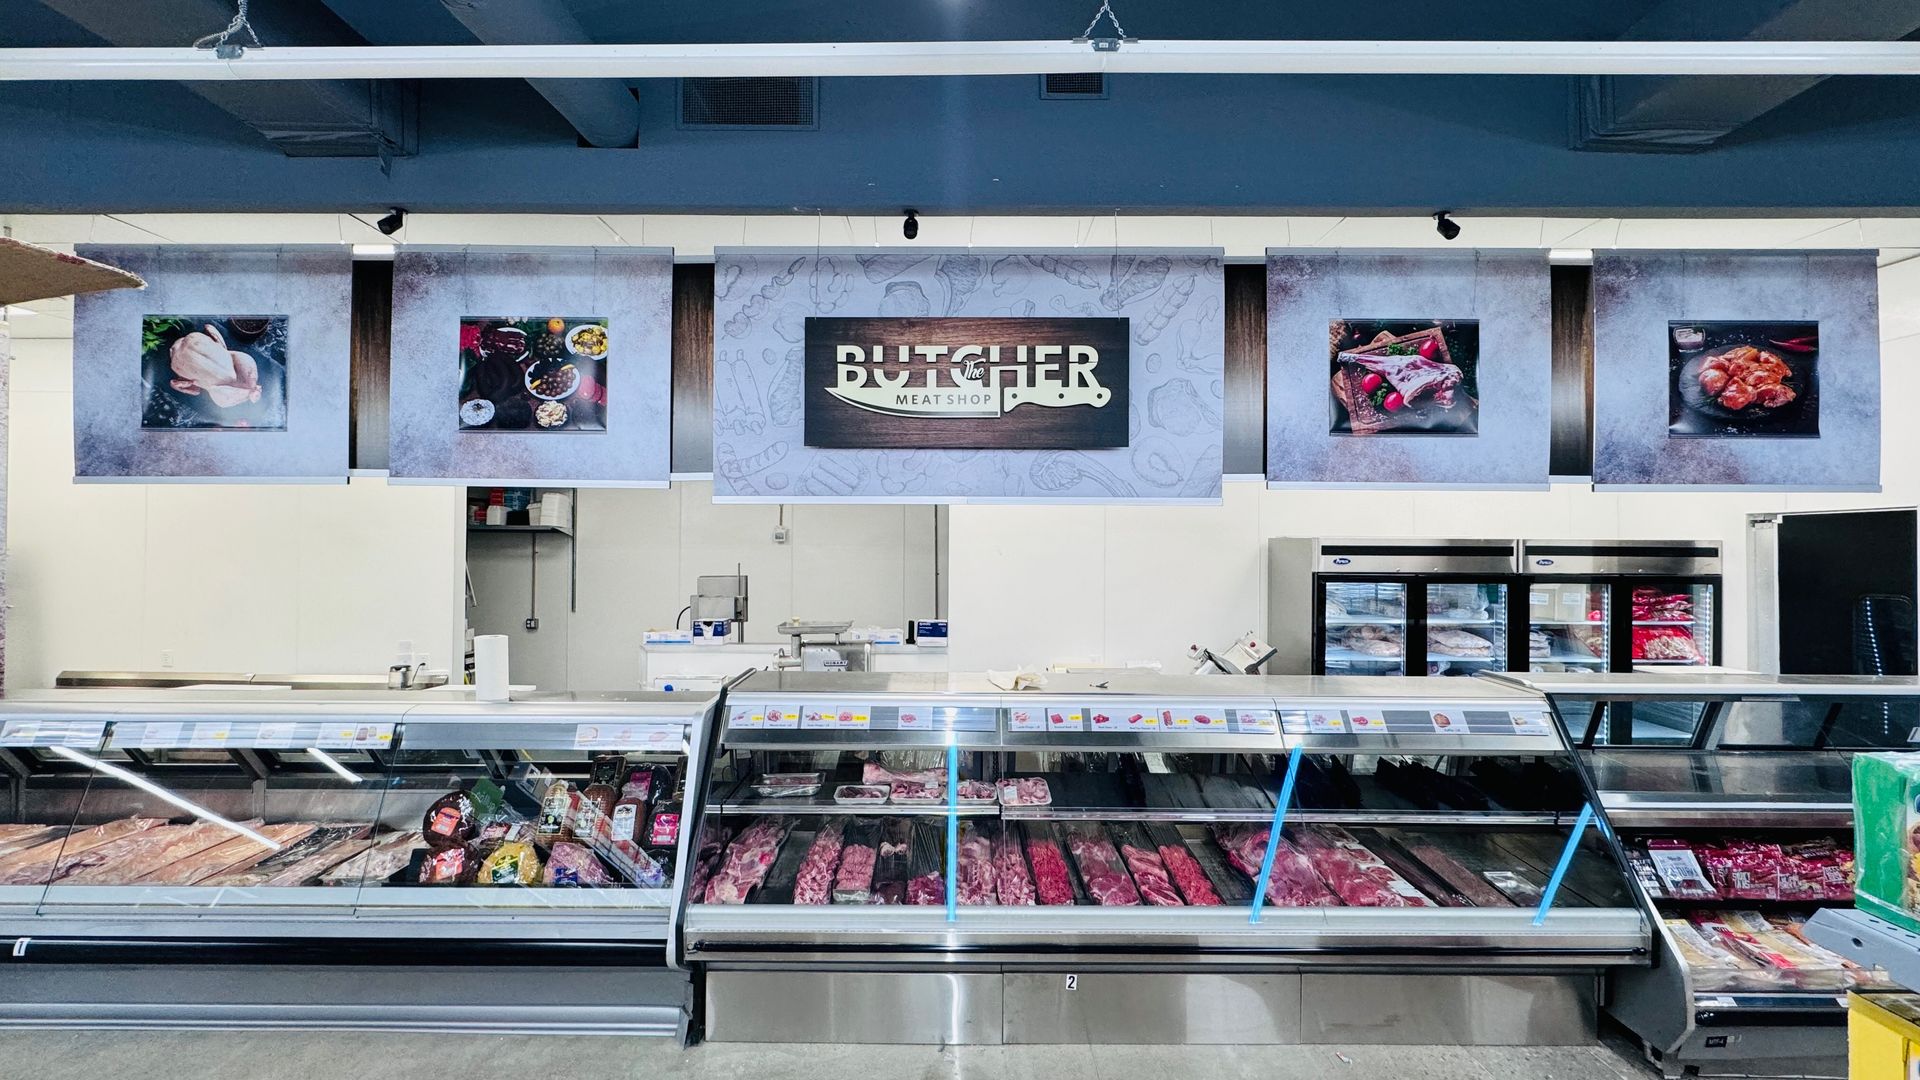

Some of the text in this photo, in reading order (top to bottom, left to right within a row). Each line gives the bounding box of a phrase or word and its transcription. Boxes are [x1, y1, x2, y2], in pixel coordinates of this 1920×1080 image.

[836, 345, 1101, 389] BUTCHER
[962, 357, 987, 381] The
[895, 394, 992, 406] MEAT SHOP
[1067, 975, 1076, 989] 2
